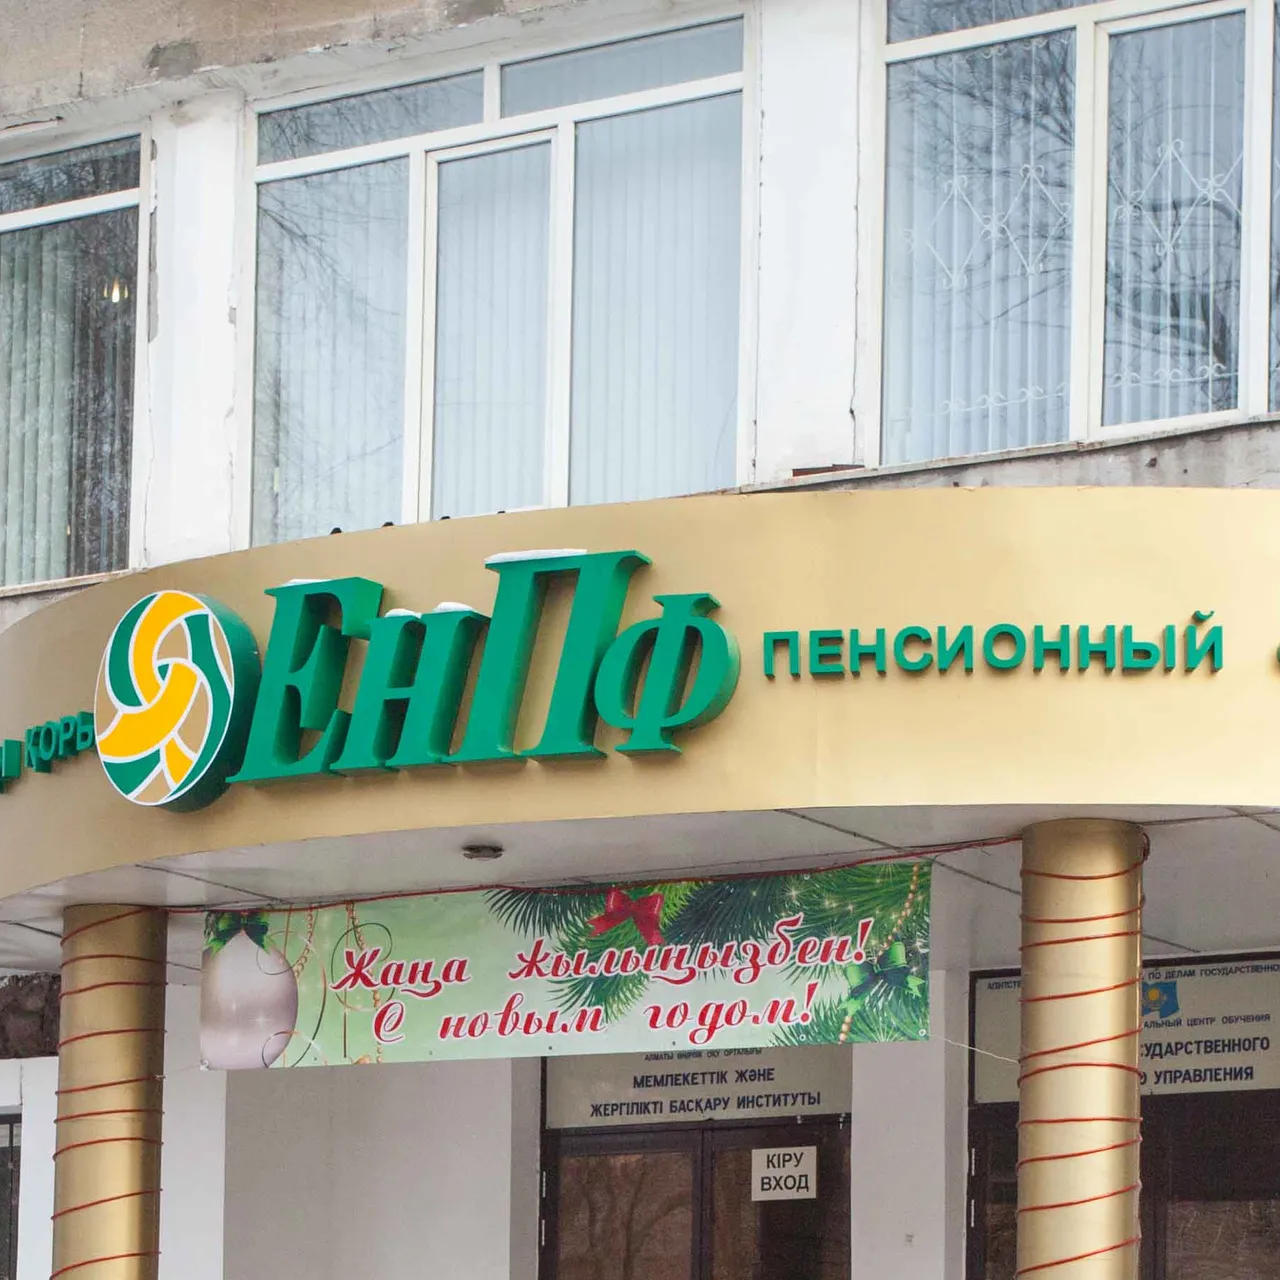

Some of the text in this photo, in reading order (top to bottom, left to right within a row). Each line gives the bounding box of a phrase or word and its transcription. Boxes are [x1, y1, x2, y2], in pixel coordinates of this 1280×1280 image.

[762, 609, 1225, 680] ПЕНСИОННЫЙ
[331, 914, 873, 998] Жаңа жылыңызбен!
[1165, 969, 1196, 980] ДЕЛАМ
[373, 982, 818, 1046] С новым годом!
[1144, 1013, 1271, 1029] АЛЬНЫЙ ЦЕНТР ОБУЧЕНИЯ
[1140, 1036, 1270, 1059] УДАРСТВЕННОГО
[633, 1067, 775, 1088] МЕМЛЕКЕТТІК ЖӘНЕ
[1154, 1066, 1254, 1085] УПРАВЛЕНИЯ
[590, 1091, 821, 1117] ЖЕРГІЛІКТІ БАСҚАРУ ИНСТИТУТЫ
[766, 1152, 804, 1169] КІРУ
[761, 1173, 810, 1192] ВХОД
